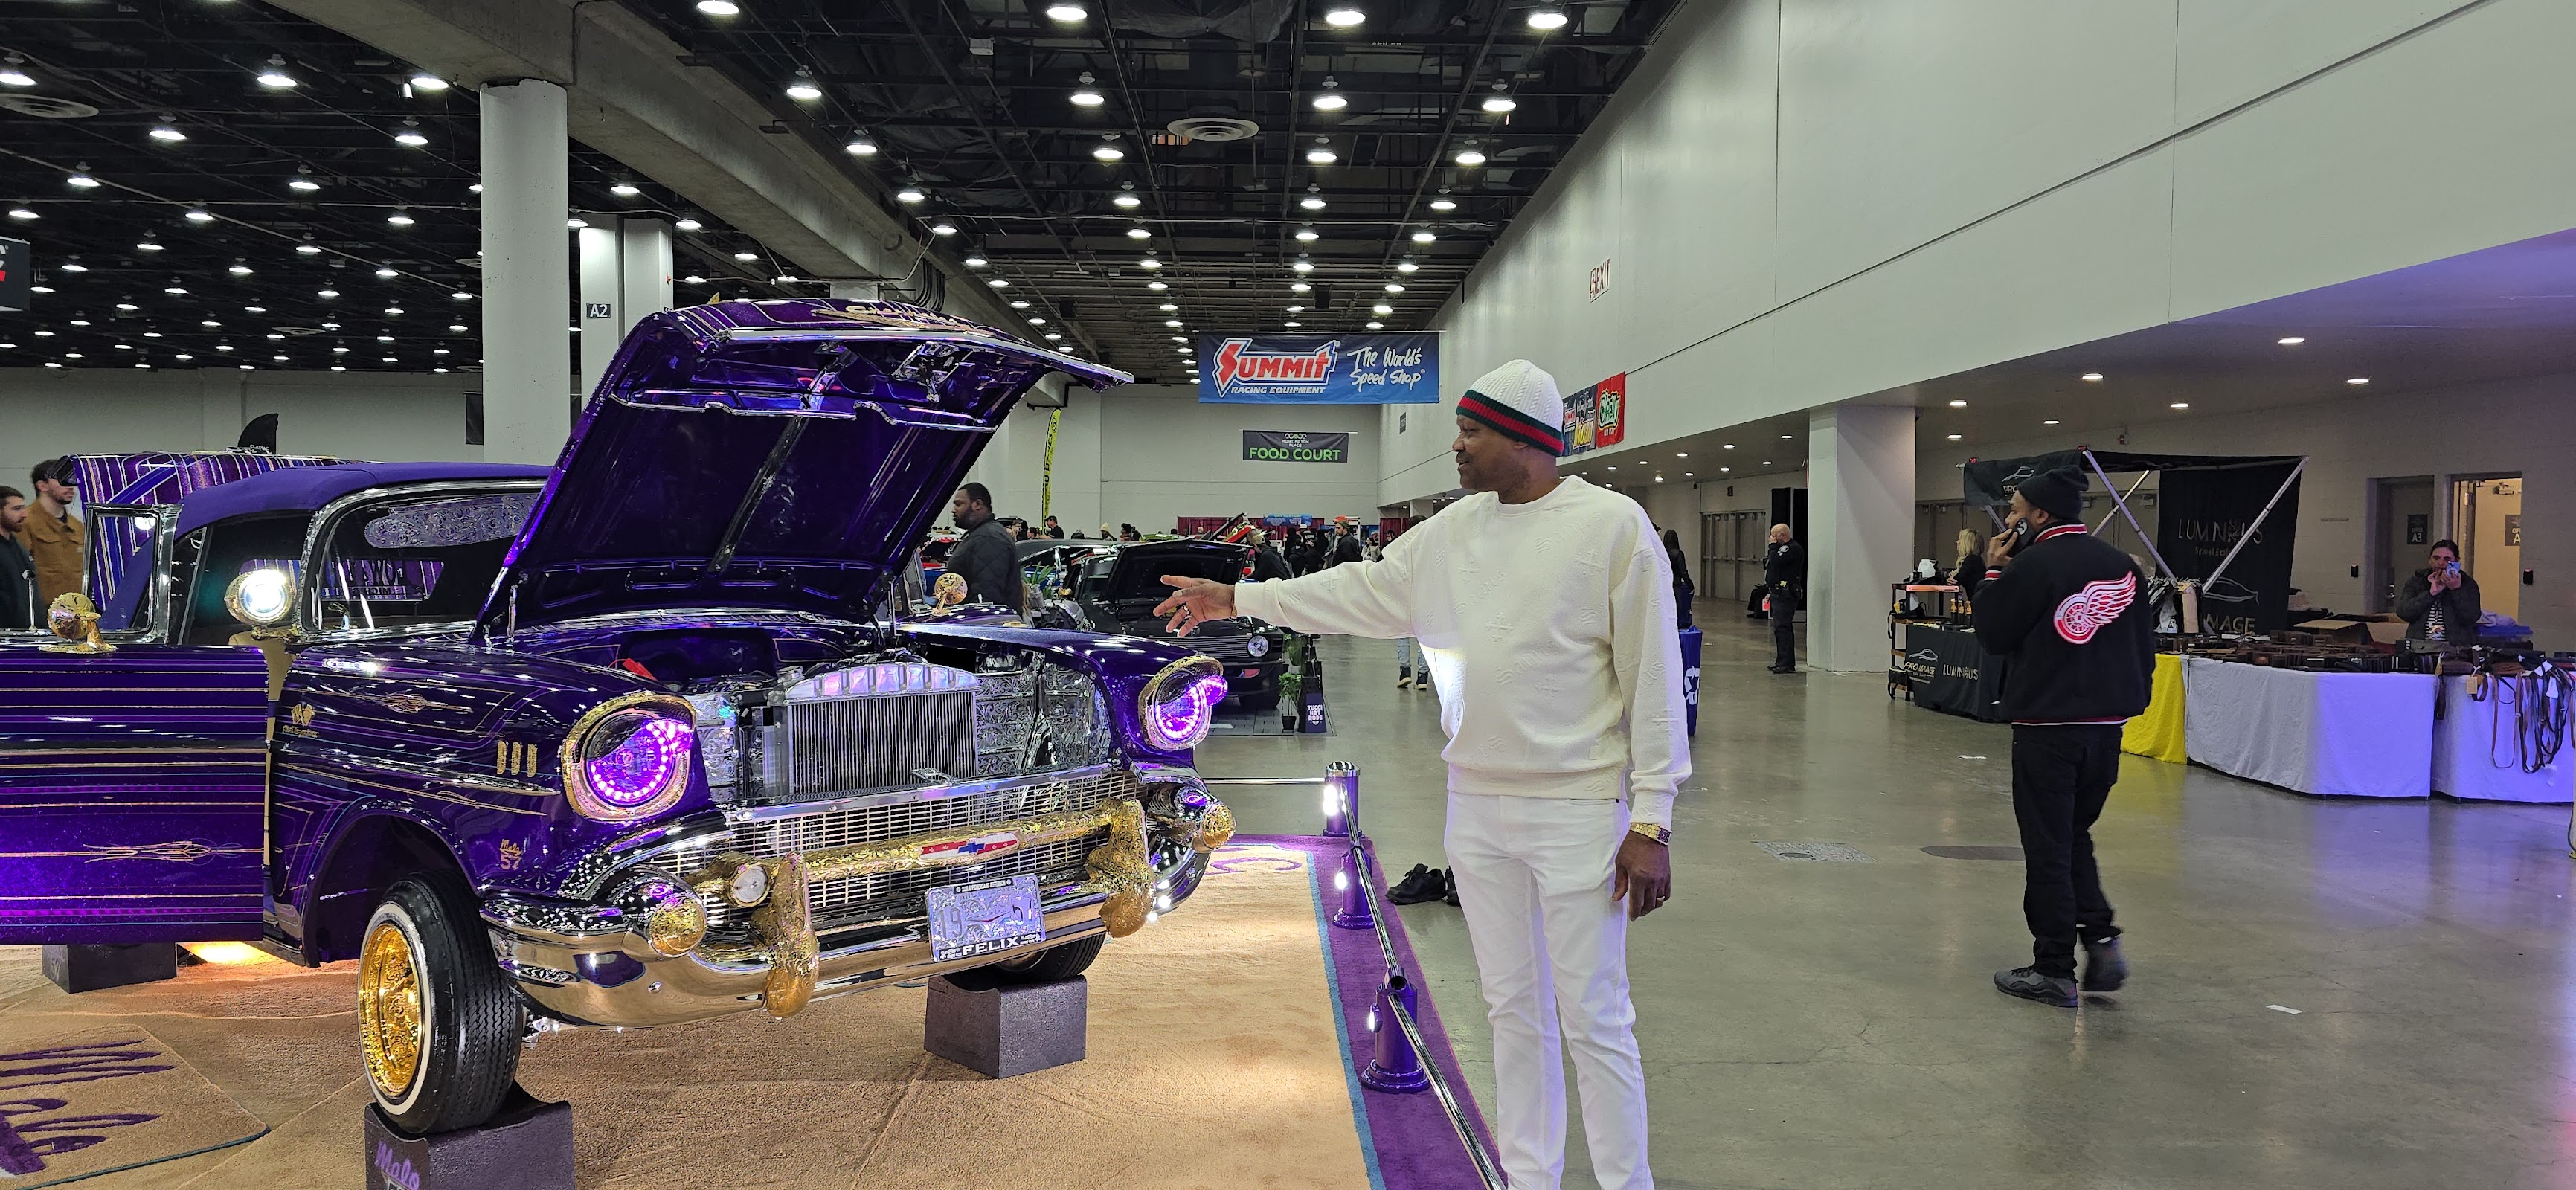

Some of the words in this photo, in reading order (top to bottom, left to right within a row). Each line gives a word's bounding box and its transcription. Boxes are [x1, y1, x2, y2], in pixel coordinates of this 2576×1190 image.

[1596, 258, 1610, 294] EXIT
[590, 303, 608, 318] A2
[1347, 346, 1378, 370] The
[1383, 347, 1422, 367] World's
[1349, 368, 1388, 393] Speed
[1389, 368, 1422, 393] Shop
[1231, 386, 1268, 394] RACING
[1269, 386, 1326, 394] EQUIPMENT
[1249, 446, 1290, 460] FOOD
[1293, 447, 1341, 461] COURT
[2412, 533, 2422, 543] A3
[2205, 612, 2256, 634] MAGE
[1904, 661, 1919, 672] PRO
[1918, 664, 1936, 675] IMAGE
[500, 854, 523, 870] 57
[963, 936, 1019, 956] FELIX
